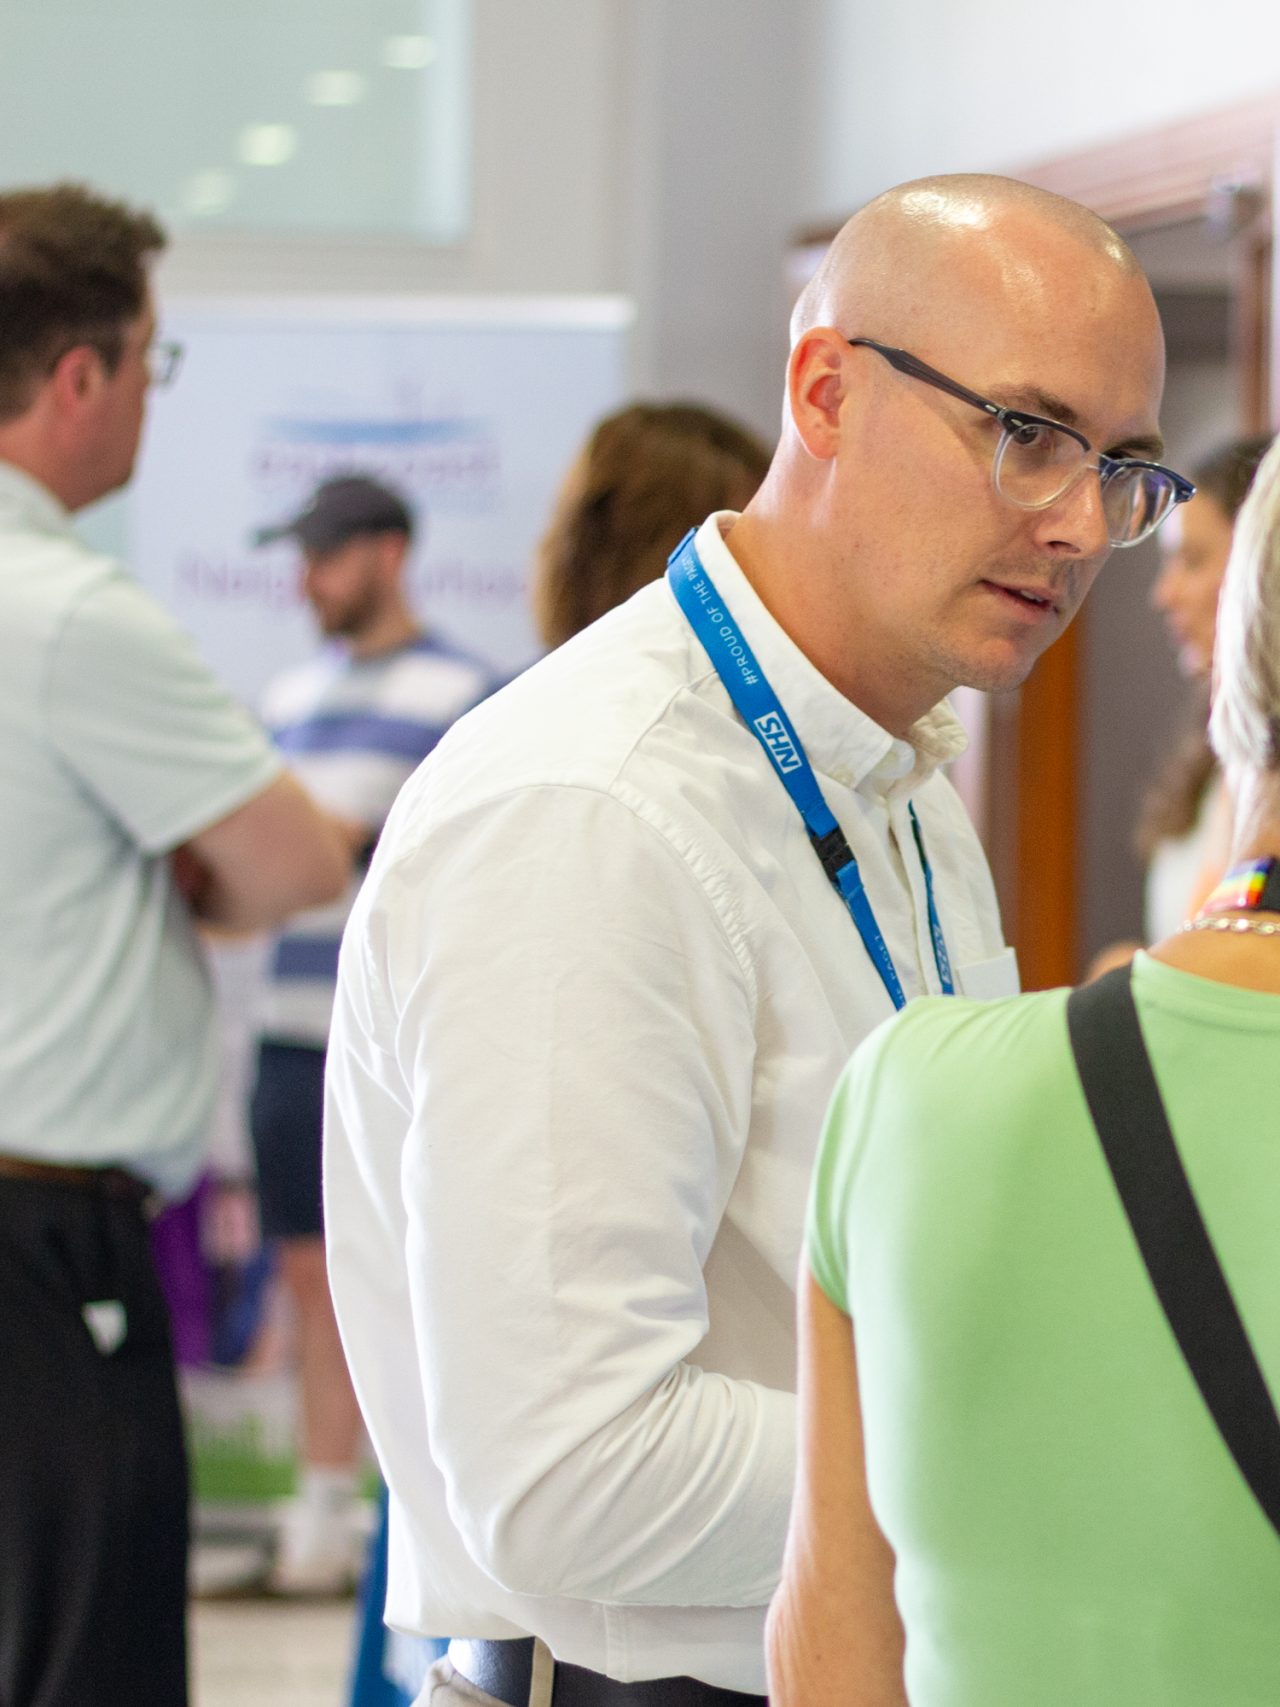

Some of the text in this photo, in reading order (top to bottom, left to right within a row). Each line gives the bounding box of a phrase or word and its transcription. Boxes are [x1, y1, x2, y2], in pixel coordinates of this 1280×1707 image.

[692, 580, 712, 605] THE
[705, 607, 724, 623] OF
[719, 626, 760, 685] #PROUD
[756, 715, 801, 769] NHS
